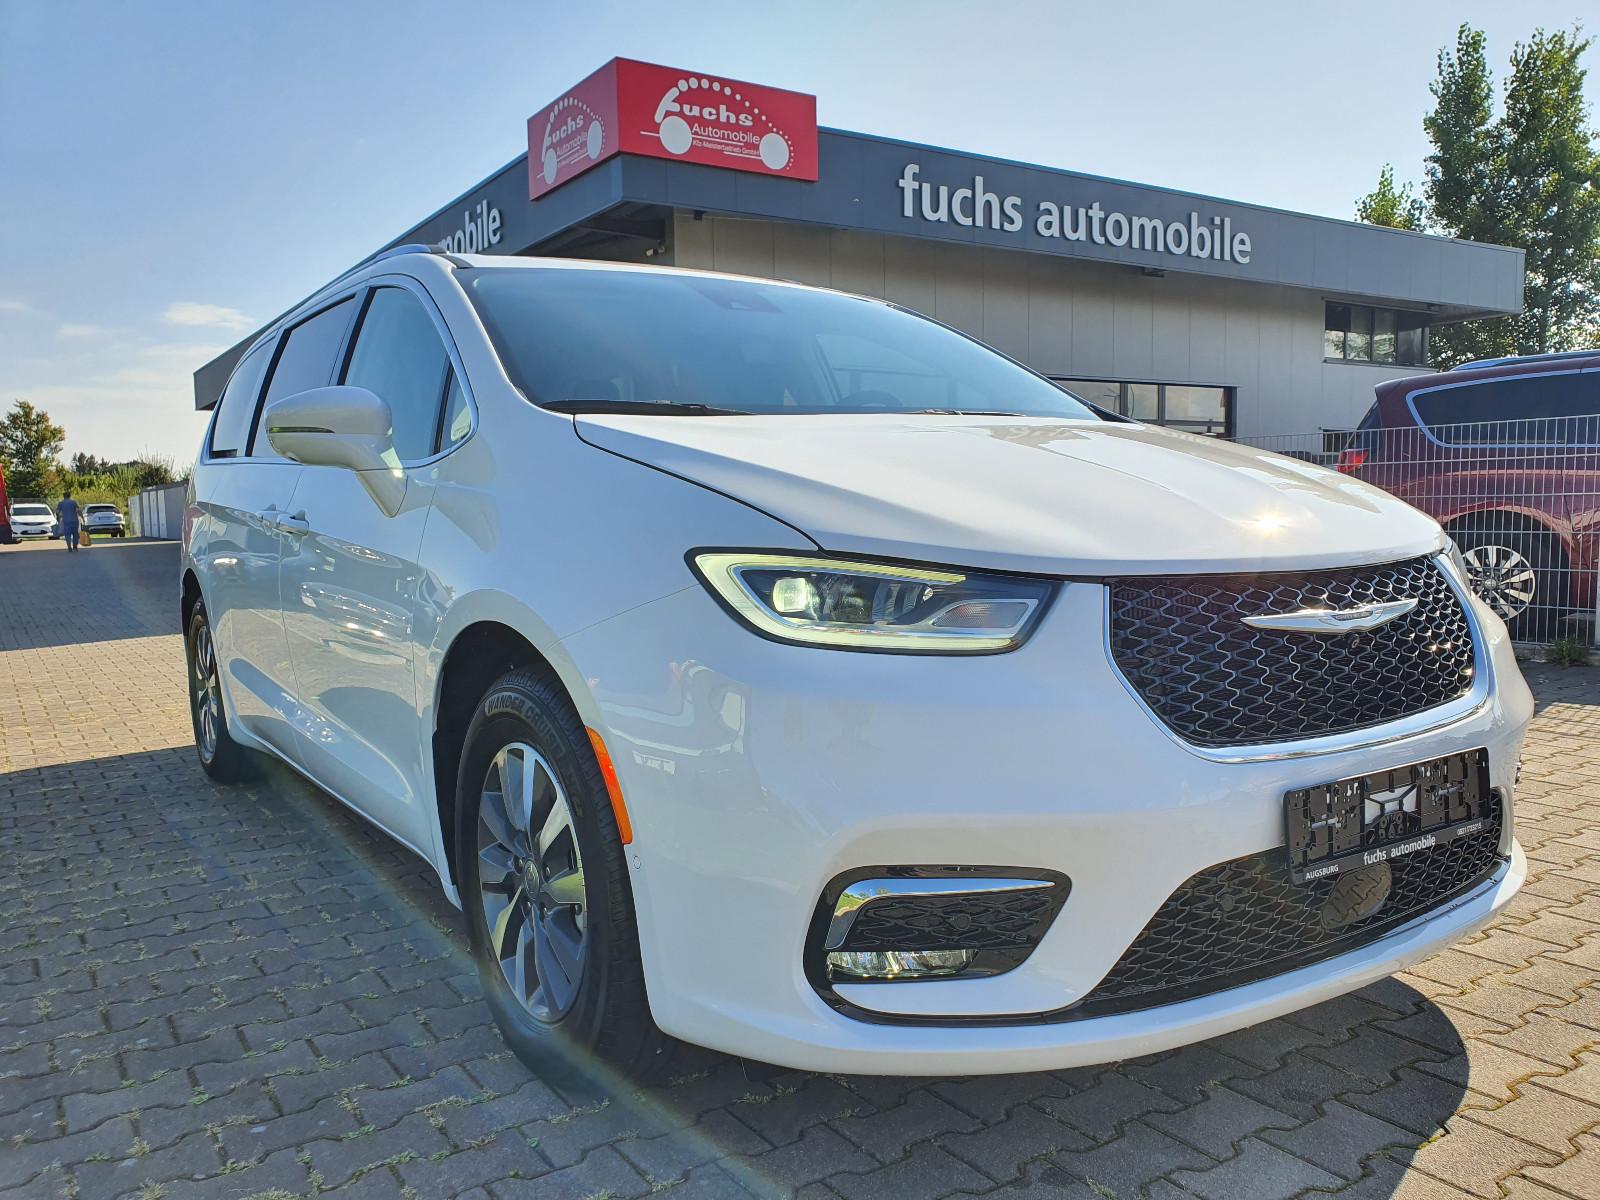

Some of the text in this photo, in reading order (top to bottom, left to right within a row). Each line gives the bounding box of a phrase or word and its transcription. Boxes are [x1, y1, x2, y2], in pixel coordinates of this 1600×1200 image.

[692, 123, 760, 144] Automobile
[898, 163, 1252, 265] fuchs automobile
[1305, 835, 1436, 881] AUGSBURG fuchs automobile
